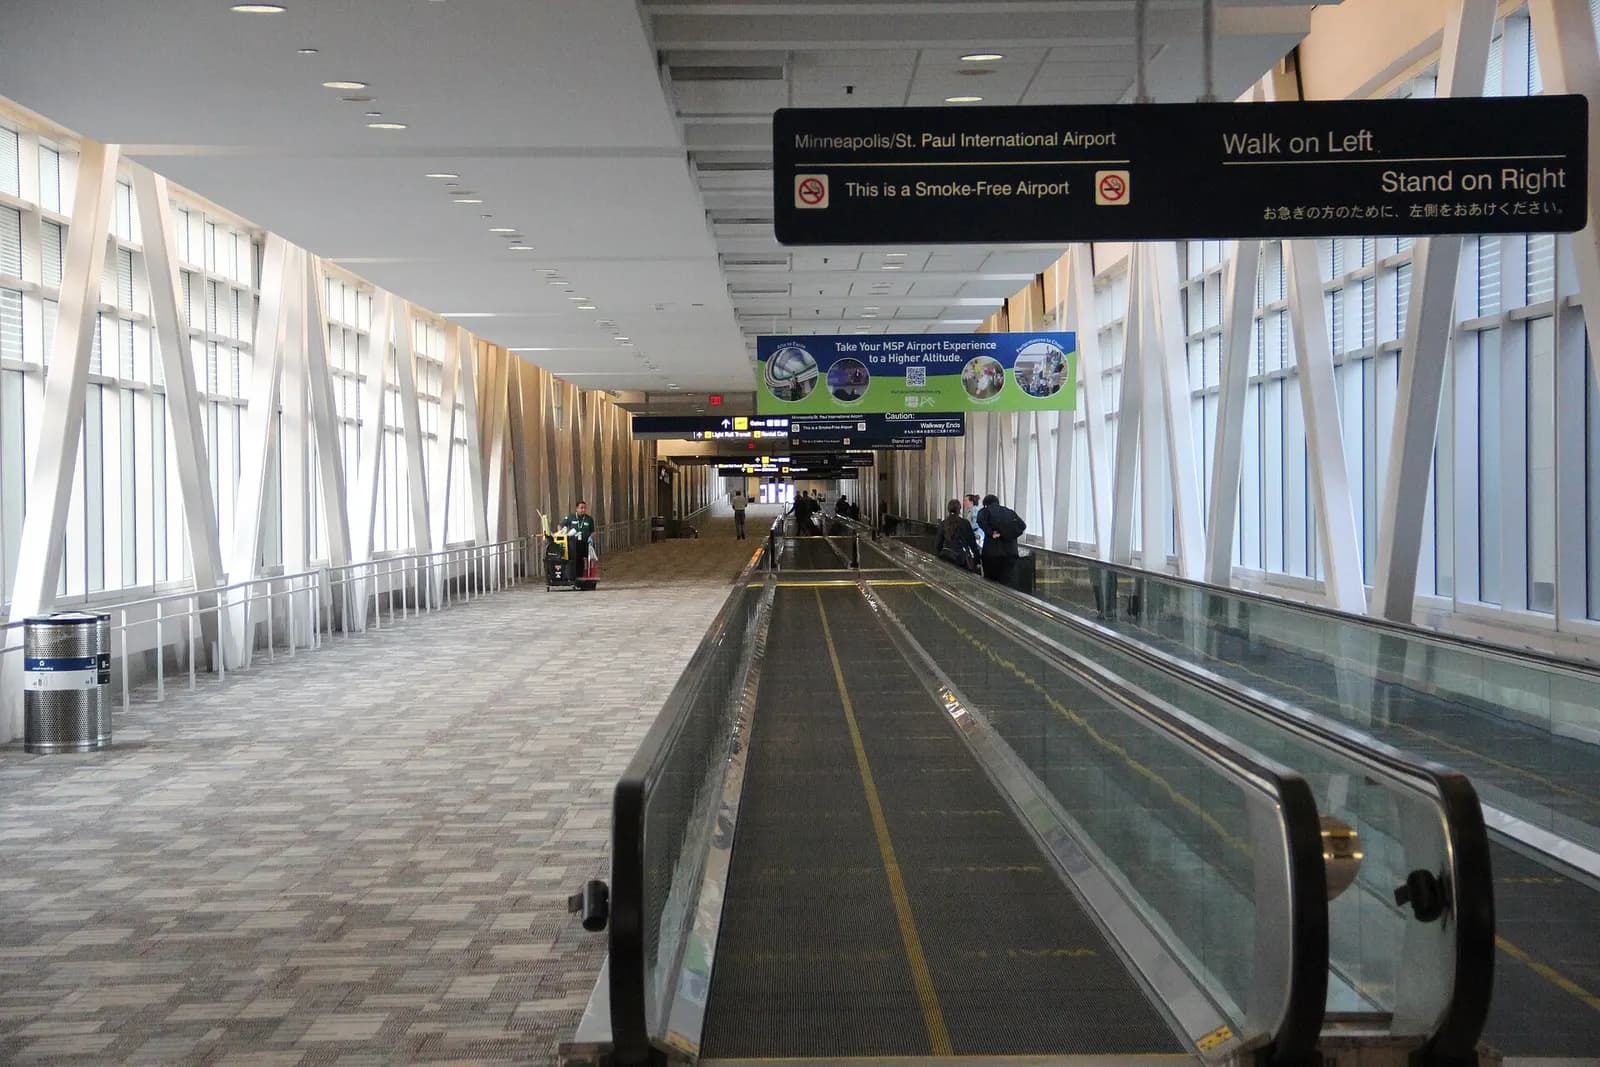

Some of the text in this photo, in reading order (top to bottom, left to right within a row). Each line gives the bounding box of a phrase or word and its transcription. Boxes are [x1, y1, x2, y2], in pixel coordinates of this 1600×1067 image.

[794, 130, 1117, 151] Minneapolis/St. Paul International Airport
[1222, 129, 1374, 155] Walk on Left
[1381, 166, 1566, 194] Stand on Right
[845, 179, 1070, 198] This is a Smoke-Free Airport
[835, 340, 997, 353] Take Your MSP Airport Experience
[869, 352, 963, 365] to a Higher Altitude.
[885, 412, 915, 420] Caution:
[920, 421, 961, 430] Walkway Ends
